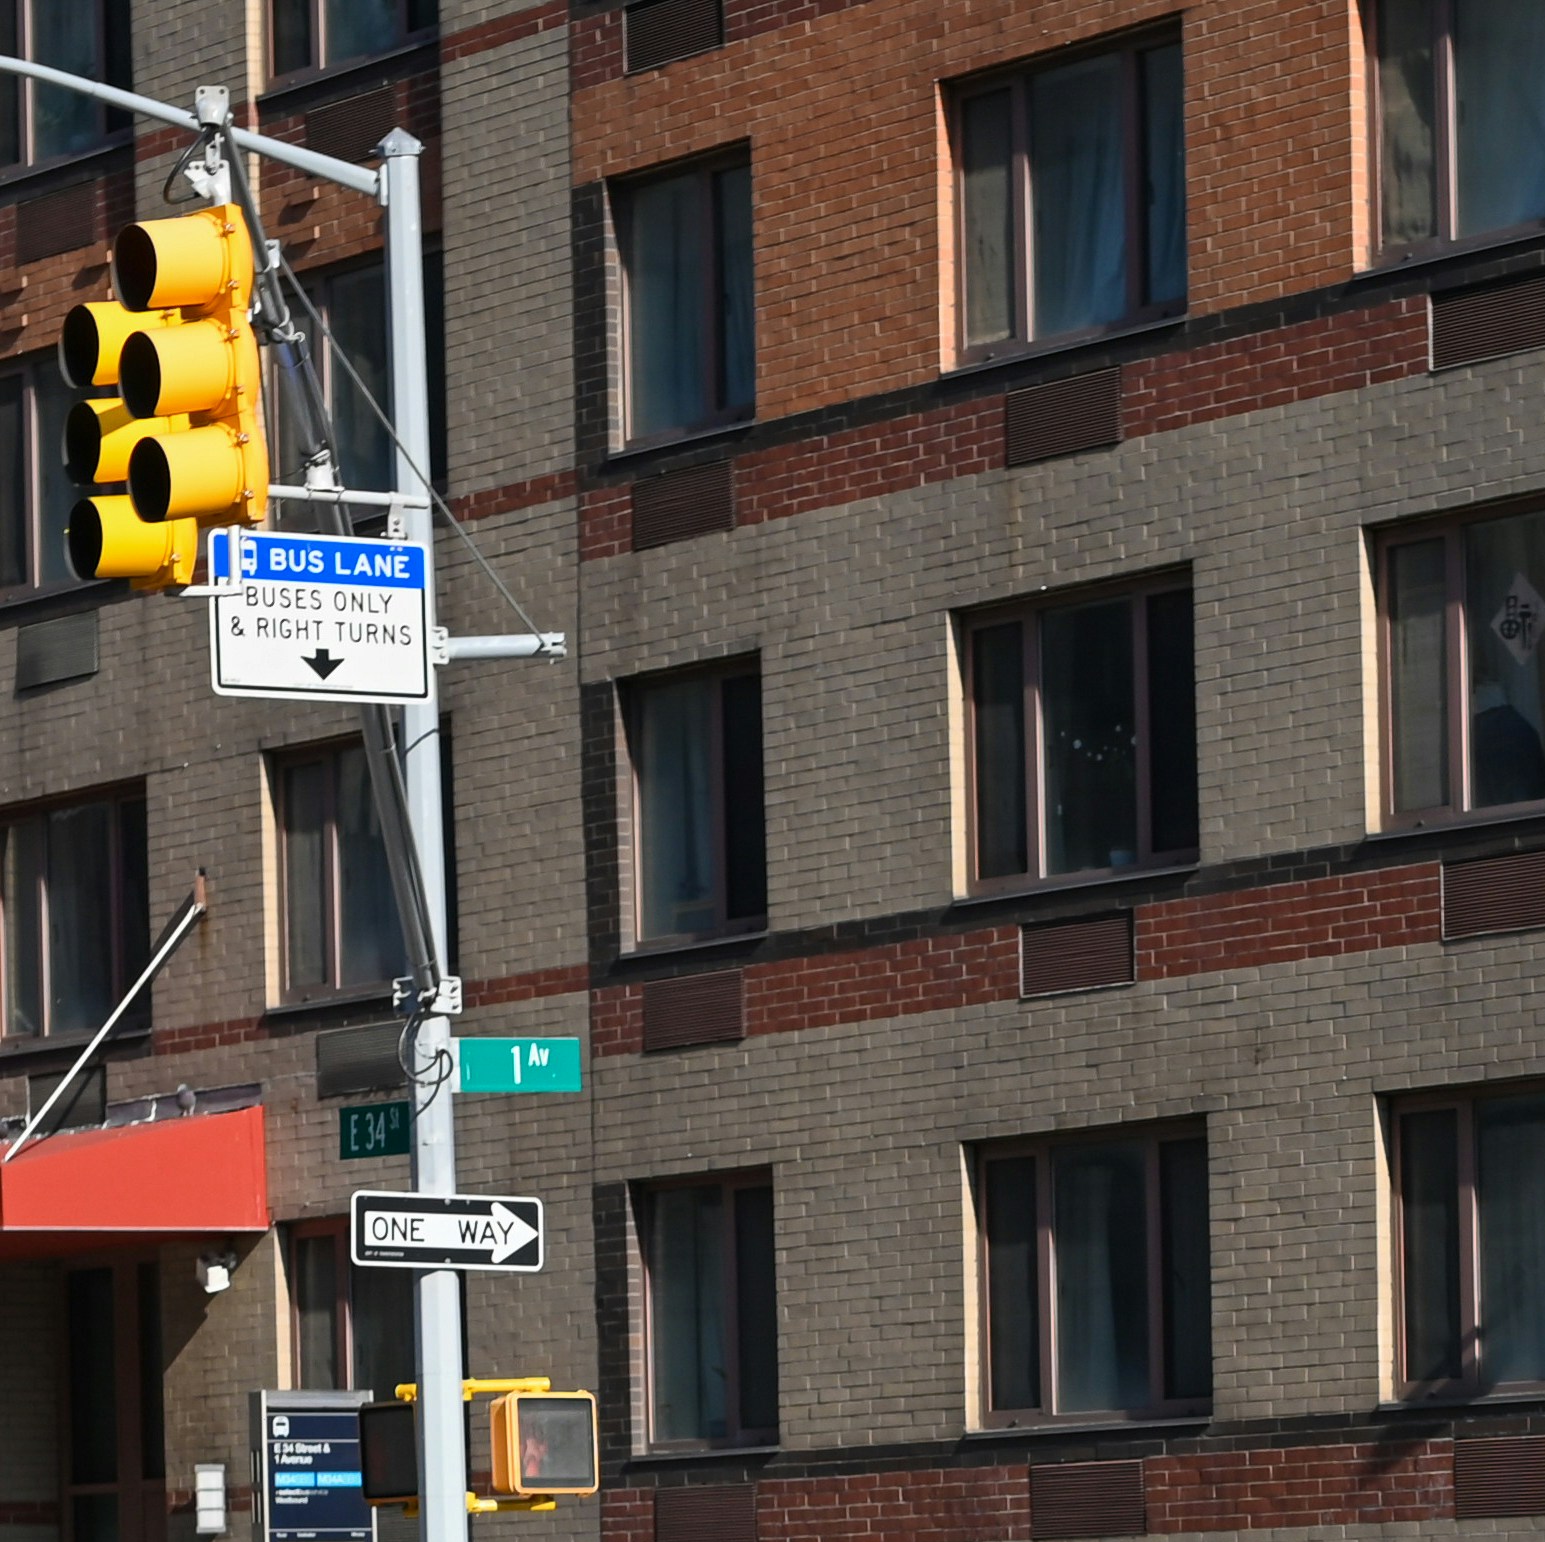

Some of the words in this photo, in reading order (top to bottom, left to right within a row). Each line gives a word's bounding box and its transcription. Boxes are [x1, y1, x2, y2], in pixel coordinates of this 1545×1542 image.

[270, 548, 325, 573] BUS
[335, 551, 411, 579] LANE
[246, 585, 322, 610] BUSES
[334, 590, 393, 614] ONLY
[231, 616, 245, 636] &
[257, 617, 323, 640] RIGHT
[335, 621, 412, 646] TURNS
[510, 1046, 521, 1085] 1
[528, 1043, 550, 1067] Av
[351, 1114, 359, 1151] E
[365, 1111, 386, 1151] 34
[389, 1106, 400, 1130] St
[371, 1216, 425, 1243] ONE
[458, 1219, 515, 1246] WAY
